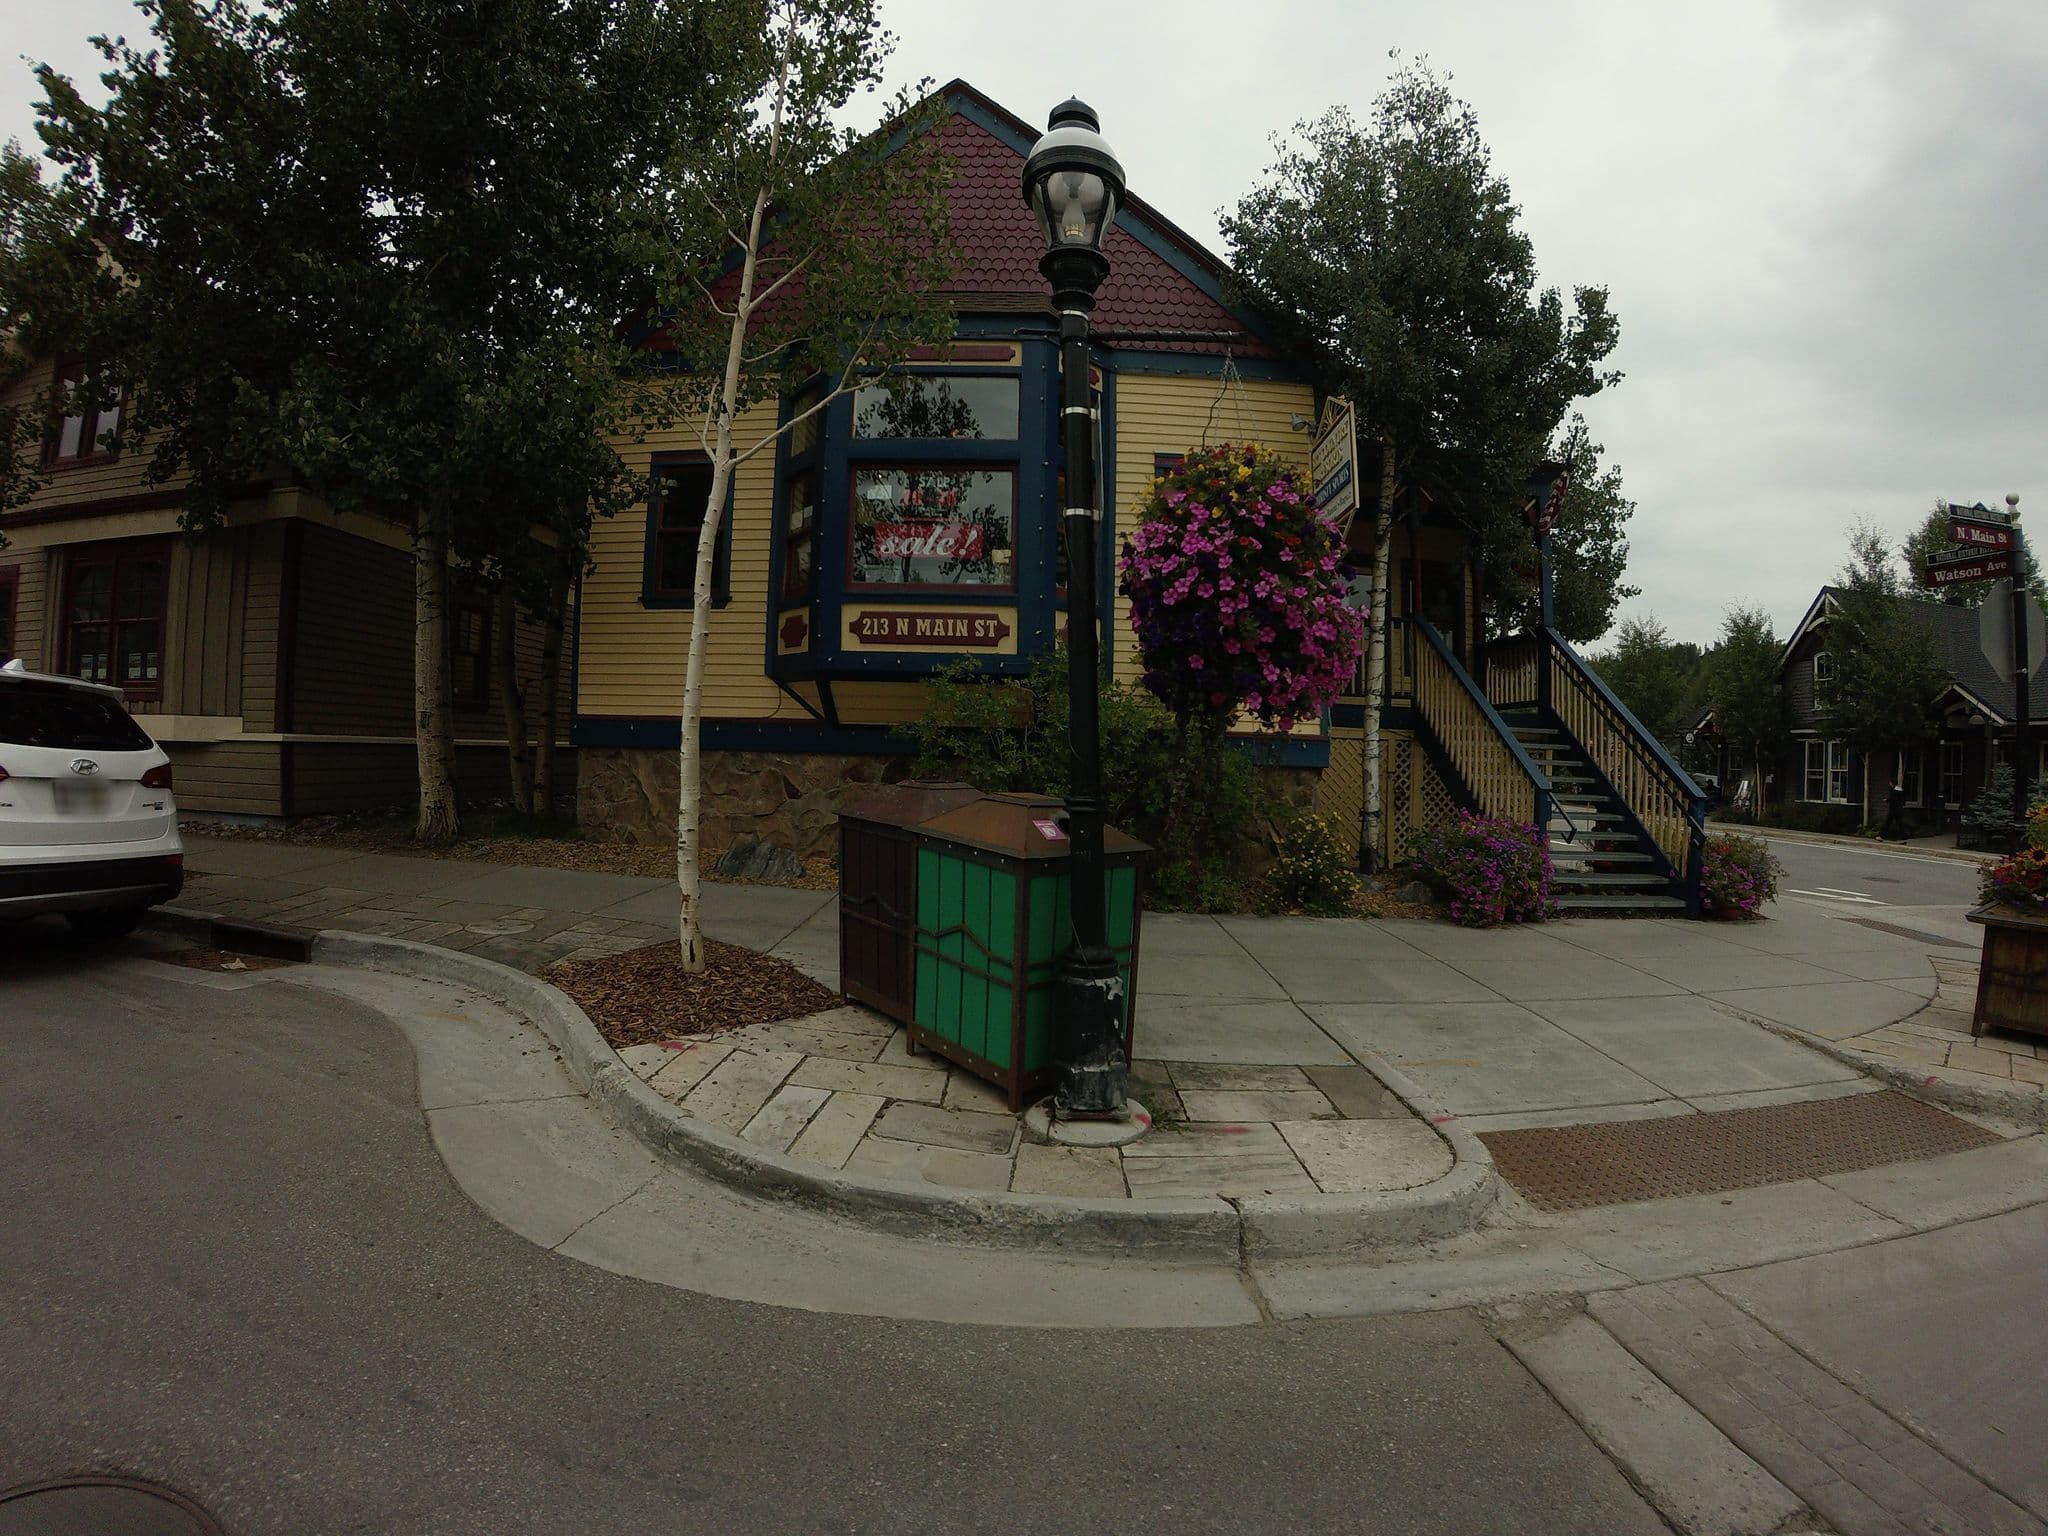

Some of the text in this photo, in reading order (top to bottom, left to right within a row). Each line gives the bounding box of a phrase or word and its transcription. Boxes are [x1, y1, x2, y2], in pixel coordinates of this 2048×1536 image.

[880, 524, 978, 556] sale!
[1957, 527, 1969, 540] N.
[1971, 529, 1996, 544] Main
[1935, 561, 2007, 582] Watson Ave
[862, 617, 998, 638] 213 N MAIN ST
